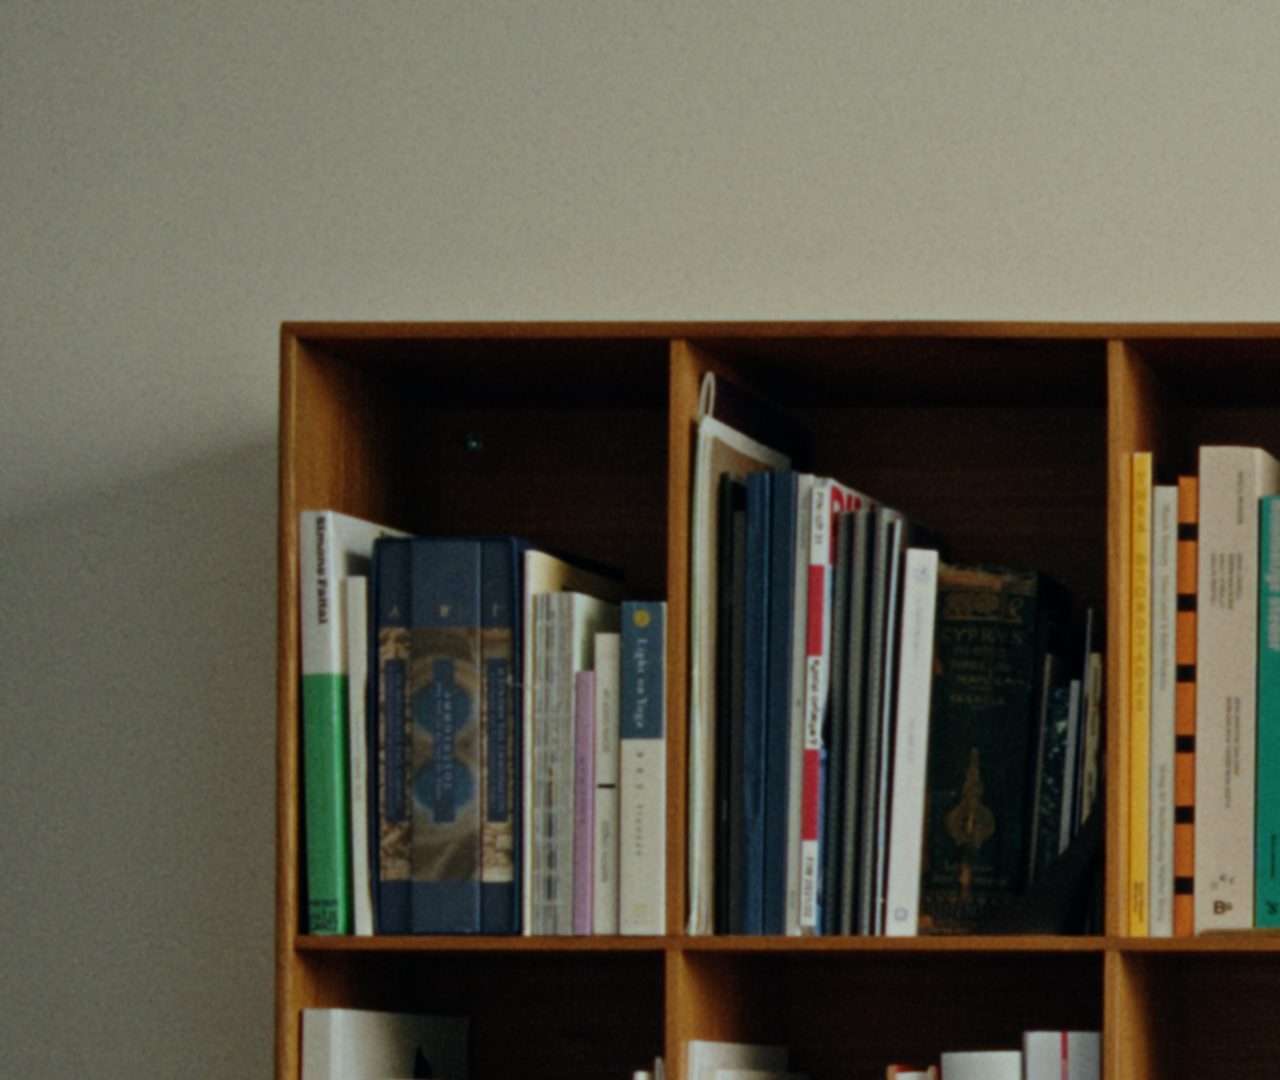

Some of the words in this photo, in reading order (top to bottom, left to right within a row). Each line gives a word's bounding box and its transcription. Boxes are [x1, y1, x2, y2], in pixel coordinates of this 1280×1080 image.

[315, 516, 328, 576] Simone
[316, 579, 329, 625] Fattal
[633, 637, 648, 674] Light
[636, 678, 645, 694] on
[633, 697, 648, 729] Yoga
